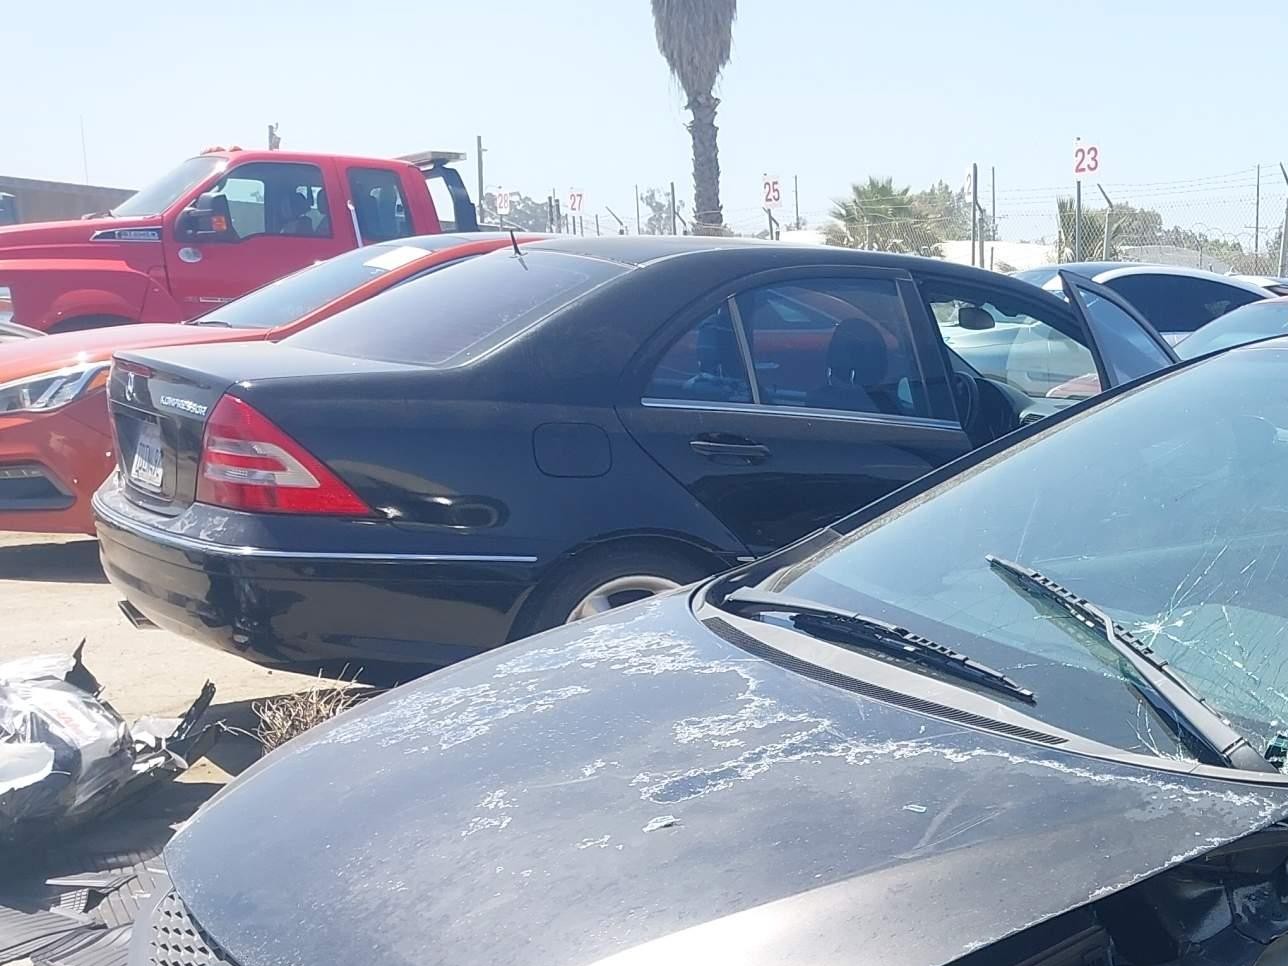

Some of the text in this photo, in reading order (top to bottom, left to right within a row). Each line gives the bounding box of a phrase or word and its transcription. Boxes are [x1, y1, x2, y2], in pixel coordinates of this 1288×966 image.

[1074, 146, 1099, 173] 23
[569, 193, 583, 212] 27
[763, 181, 781, 203] 25
[160, 395, 208, 416] KOMPRESSOR
